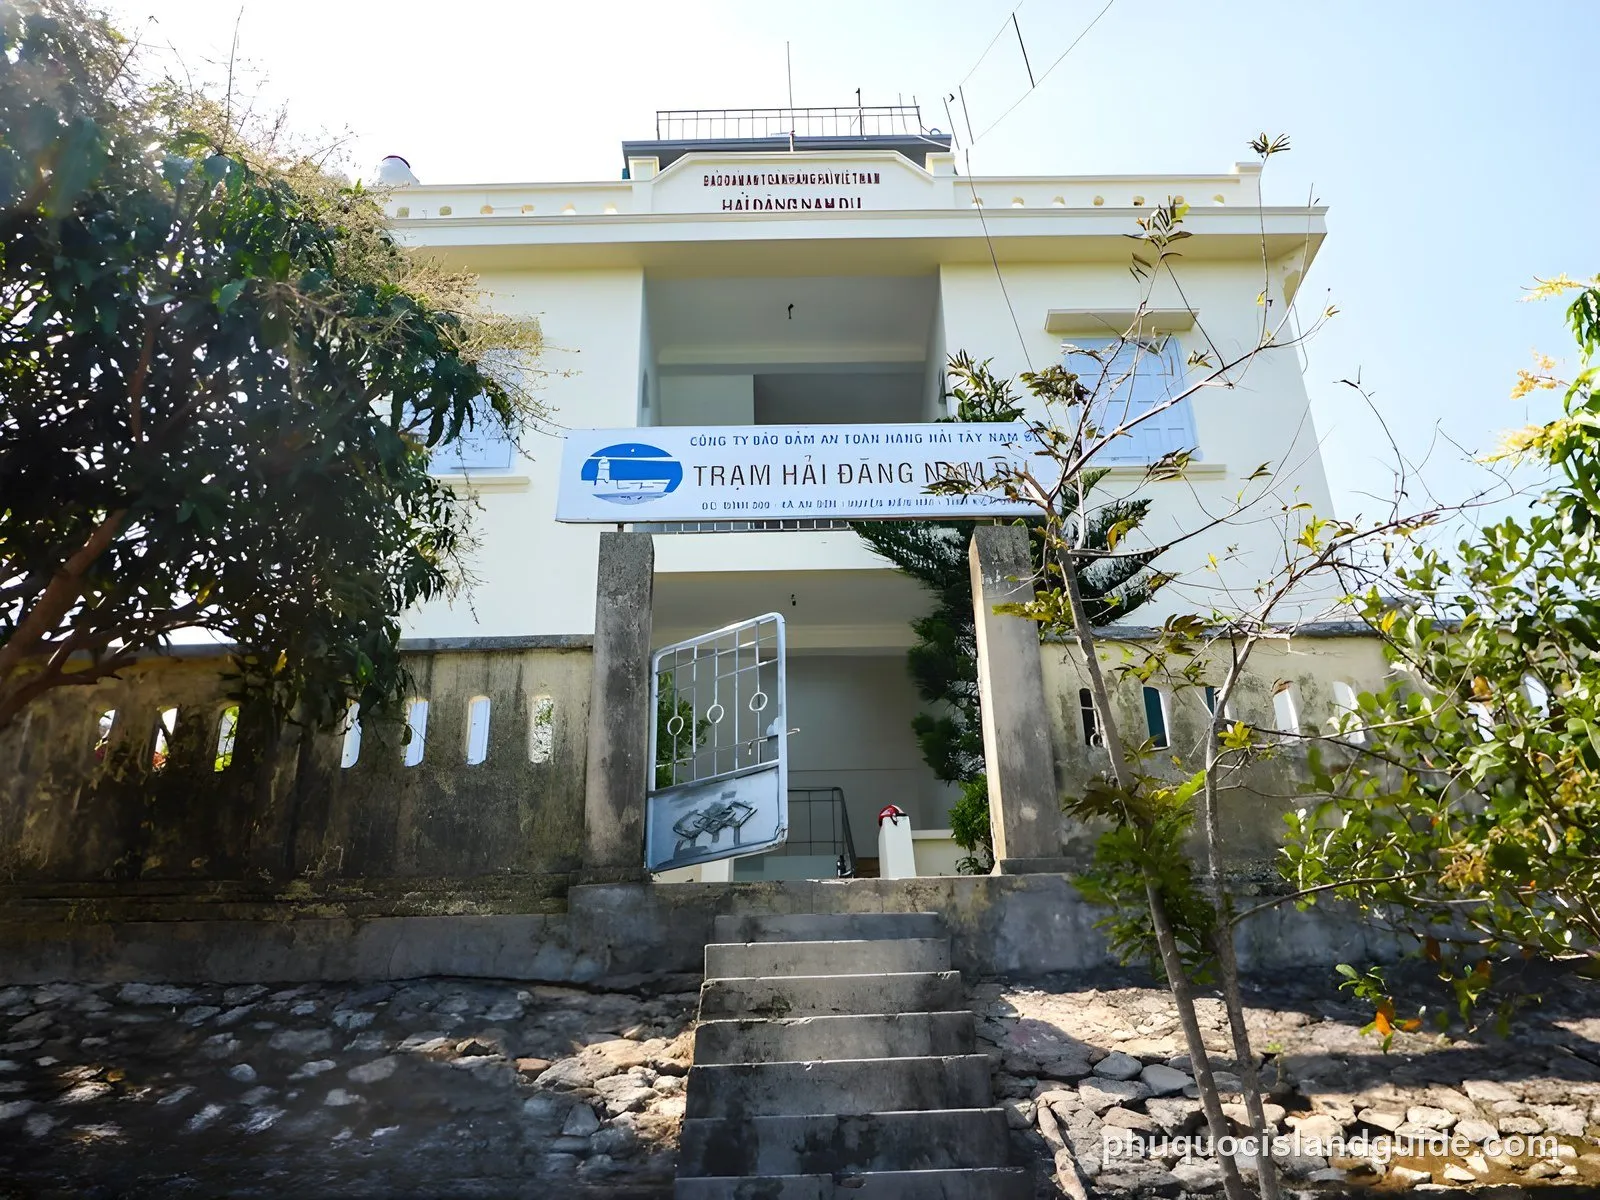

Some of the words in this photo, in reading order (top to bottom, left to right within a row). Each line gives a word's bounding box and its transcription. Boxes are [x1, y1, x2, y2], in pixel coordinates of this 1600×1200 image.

[801, 198, 835, 209] NAM
[733, 435, 749, 445] TY
[821, 434, 838, 444] AN
[989, 432, 1018, 442] NAM
[693, 464, 770, 491] TRẠM
[783, 455, 826, 485] HẢI
